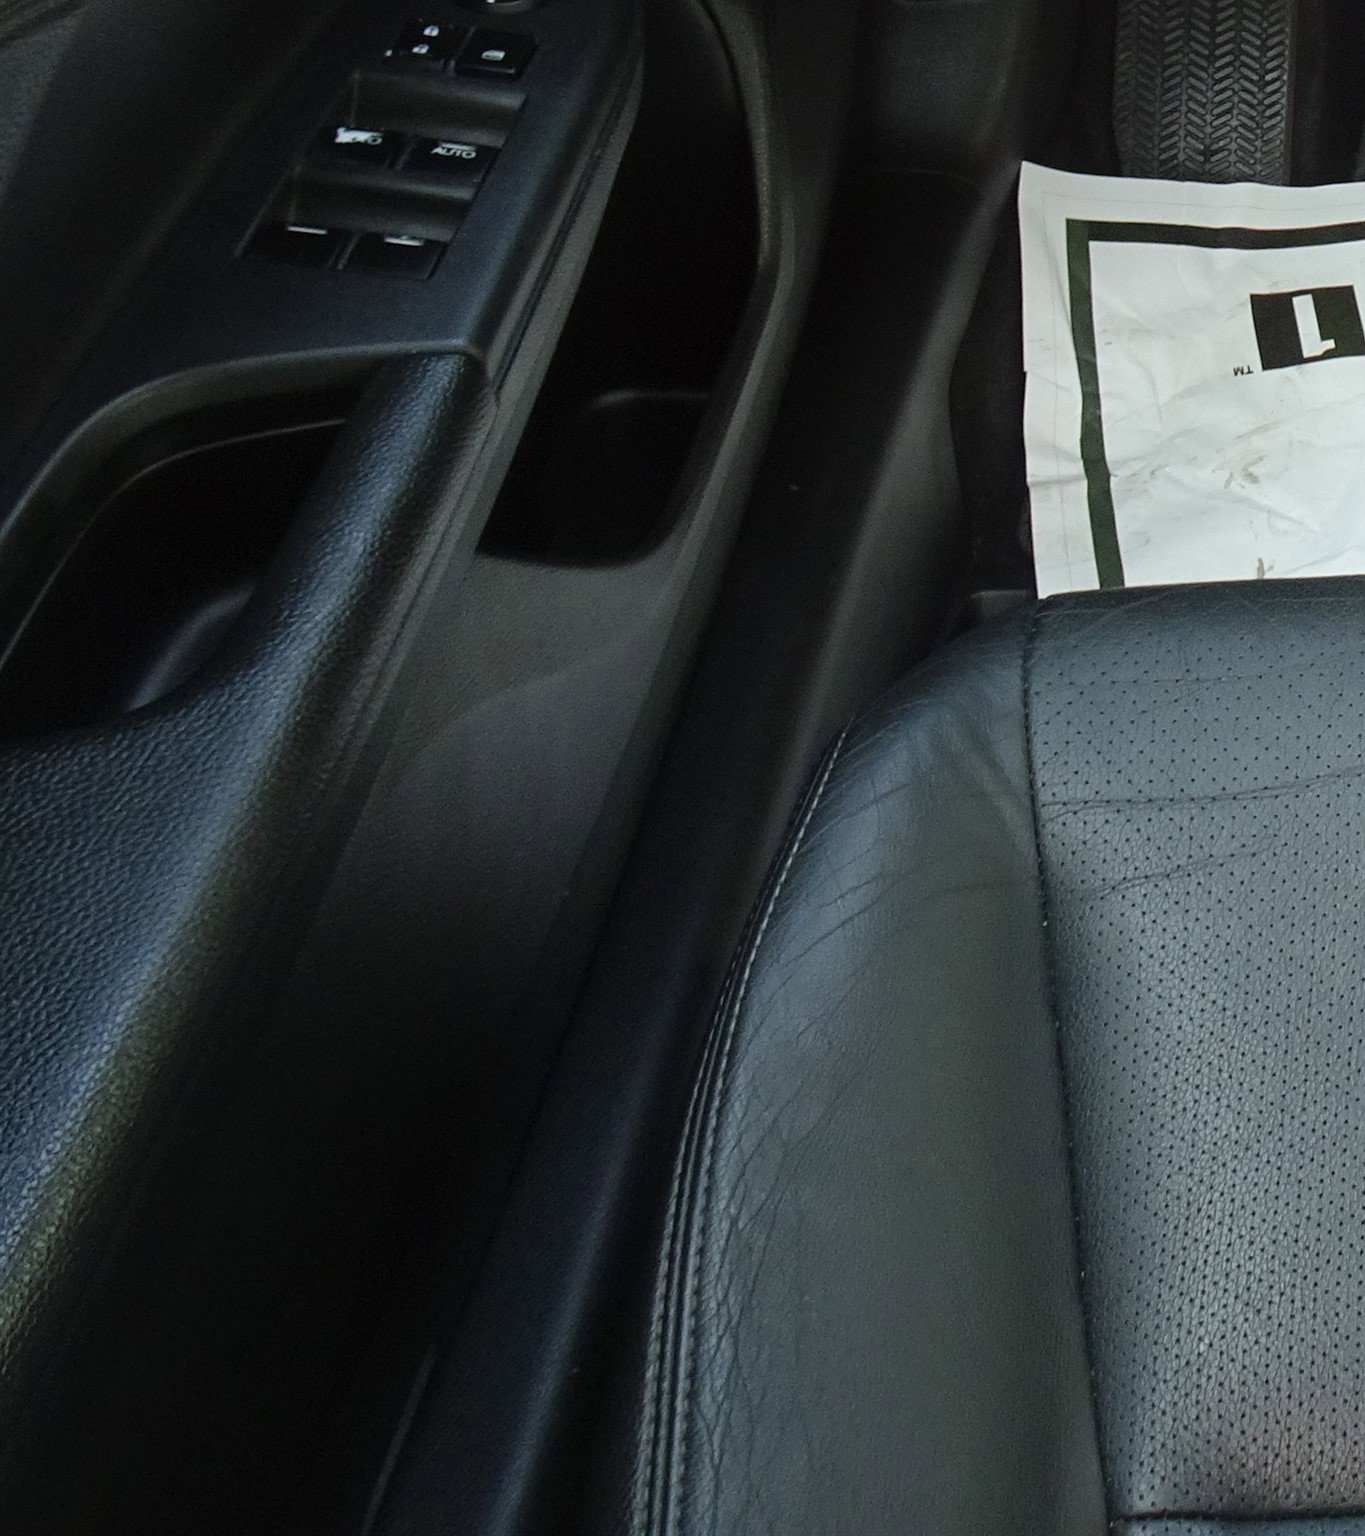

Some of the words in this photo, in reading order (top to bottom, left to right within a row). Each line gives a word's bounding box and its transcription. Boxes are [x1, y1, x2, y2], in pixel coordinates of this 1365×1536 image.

[430, 146, 477, 160] AUTO
[1291, 293, 1337, 360] 1
[1232, 368, 1254, 379] TM
